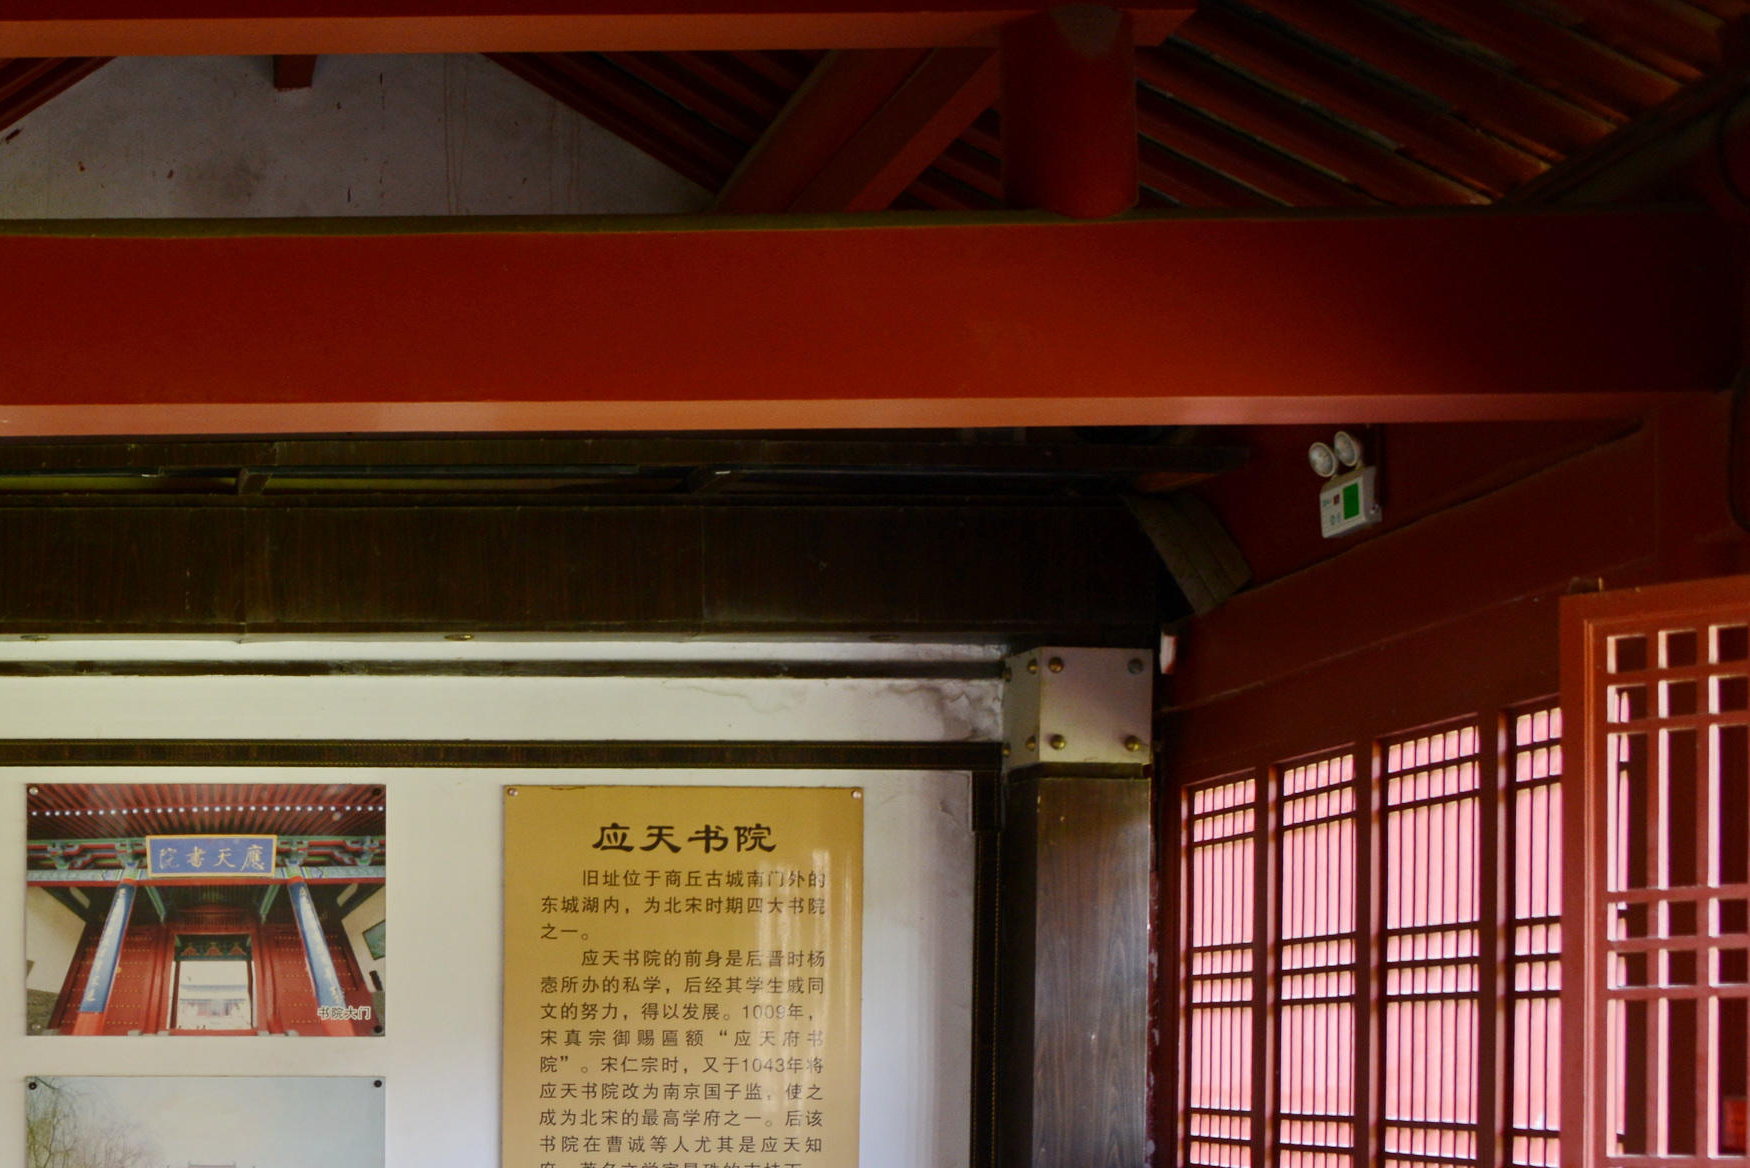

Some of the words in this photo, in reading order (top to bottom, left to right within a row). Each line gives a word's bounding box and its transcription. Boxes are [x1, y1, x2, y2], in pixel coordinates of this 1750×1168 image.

[592, 822, 776, 854] 应天书院
[582, 869, 826, 888] 旧址位于商丘古城南门外的
[541, 896, 826, 914] 东城湖内，为北宋时期四大书院
[541, 924, 589, 941] 之一。
[581, 949, 825, 967] 应天书院的前身是后晋时杨
[317, 1005, 371, 1020] 书院大门
[540, 1003, 815, 1021] 文的努力，得以发展。1009年，
[540, 1056, 824, 1074] 院”。宋仁宗时，又于1043年将
[539, 1082, 823, 1101] 应天书院改为南京国子监，使之
[539, 1109, 823, 1127] 成为北宋的最高学府之一。后该
[539, 1135, 822, 1154] 书院在曹诚等人尤其是应天知
